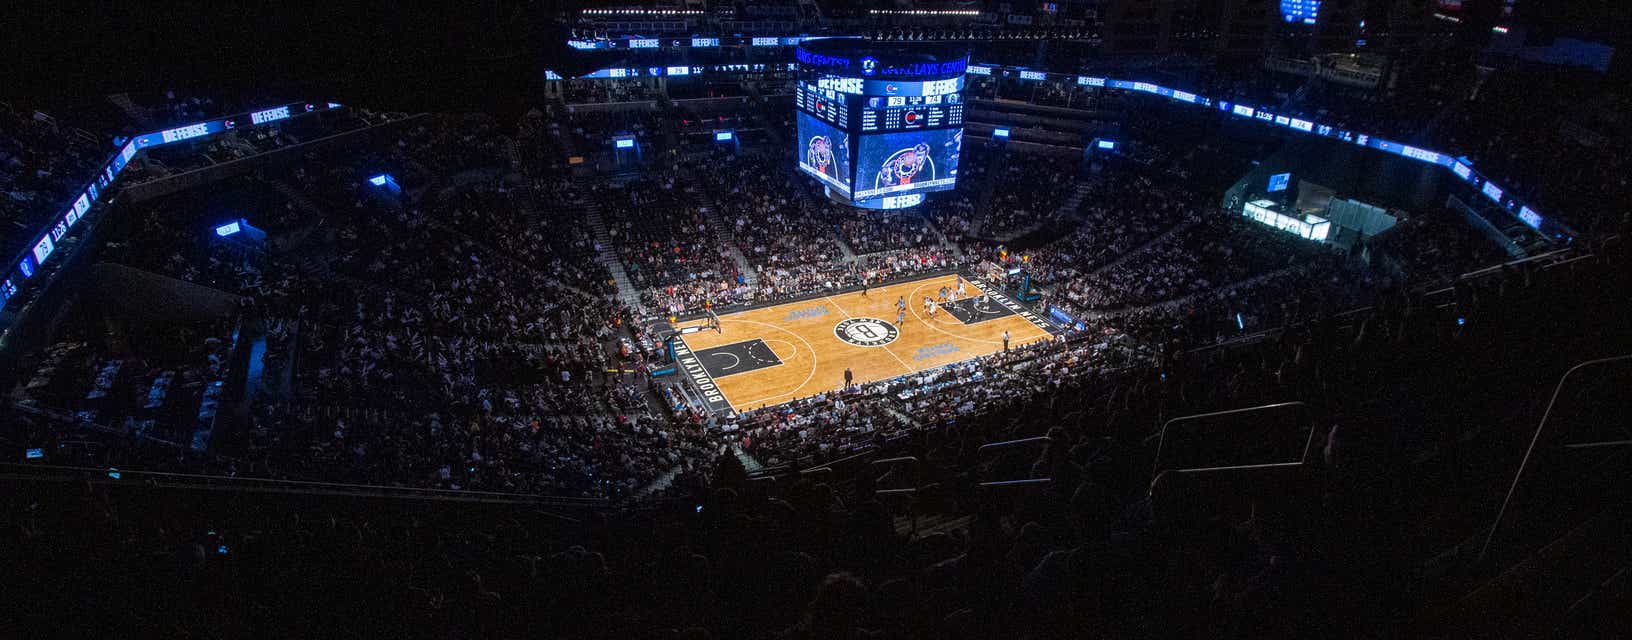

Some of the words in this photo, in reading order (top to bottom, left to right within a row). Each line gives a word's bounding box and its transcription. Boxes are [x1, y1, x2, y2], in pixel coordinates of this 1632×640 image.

[629, 39, 659, 48] DEFENSE
[752, 37, 779, 46] DEFENSE
[818, 78, 864, 95] DEFENSE
[1078, 76, 1106, 86] DEFENSE
[251, 106, 289, 125] DEFENSE
[162, 122, 208, 143] DEFENSE
[1020, 311, 1051, 328] NETS
[682, 357, 724, 403] BROOKLYN
